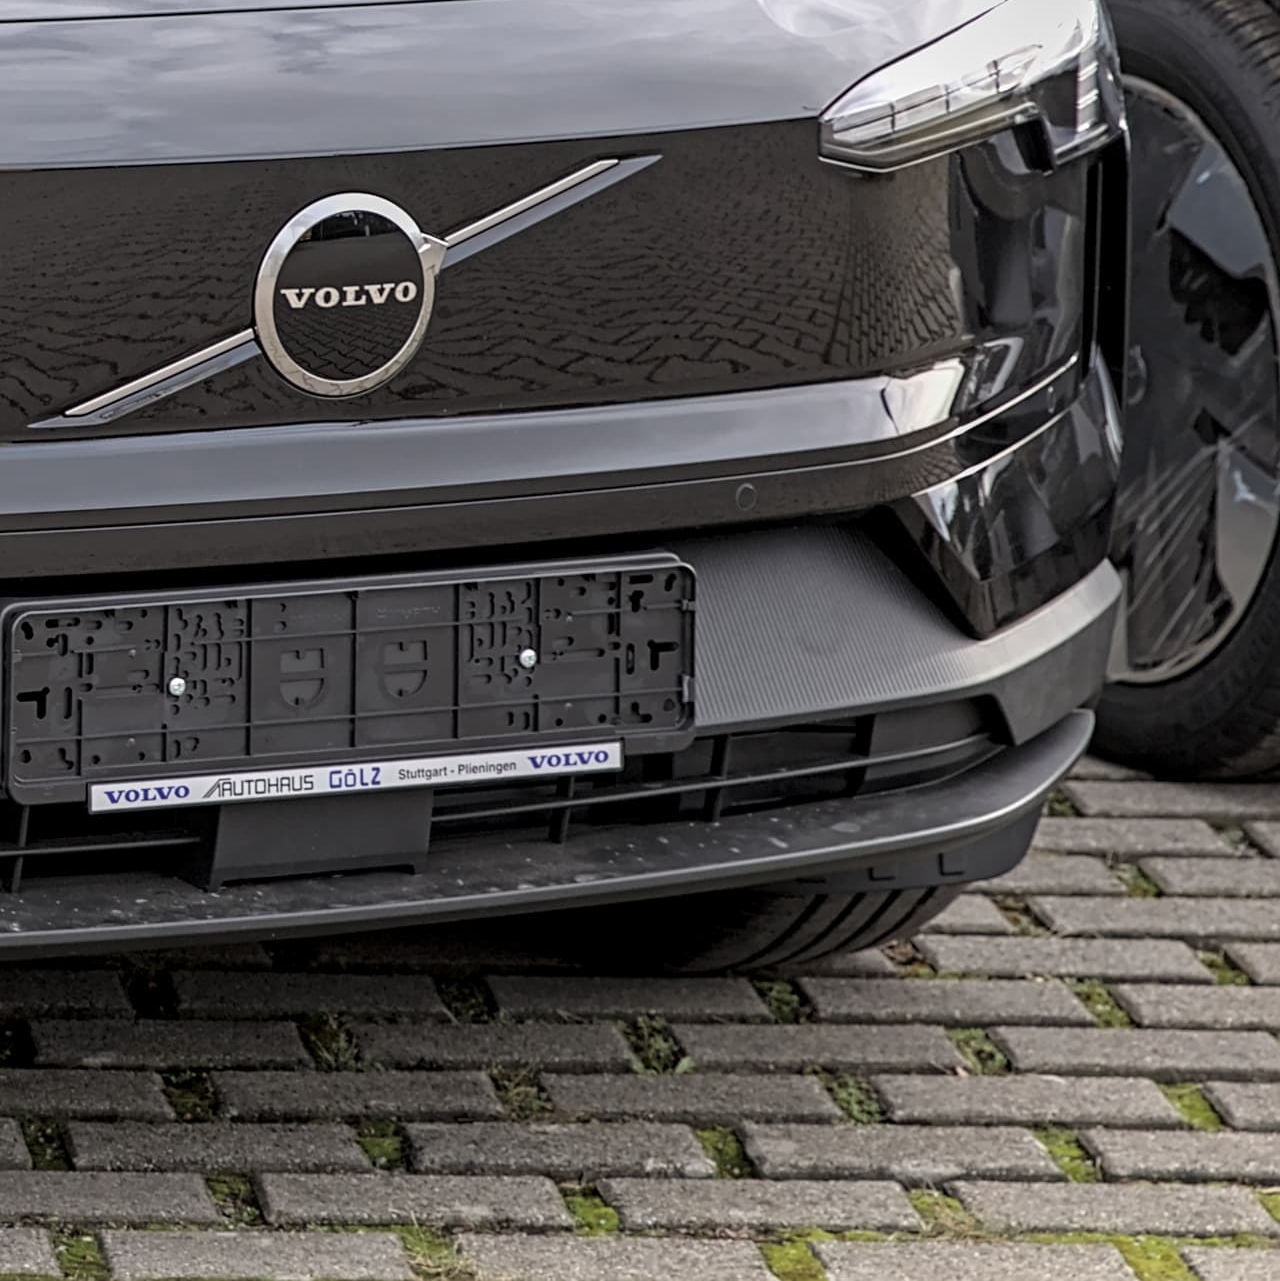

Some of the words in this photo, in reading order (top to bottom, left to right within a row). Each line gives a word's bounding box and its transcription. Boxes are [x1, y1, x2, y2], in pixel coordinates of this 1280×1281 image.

[280, 281, 418, 309] VOLVO
[104, 784, 191, 805] VOLVO
[203, 773, 315, 799] AUTOHAUS
[328, 766, 382, 790] GÖLZ
[398, 764, 449, 781] Stuttgart
[458, 760, 517, 777] Plieningen
[527, 749, 610, 769] VOLVO
